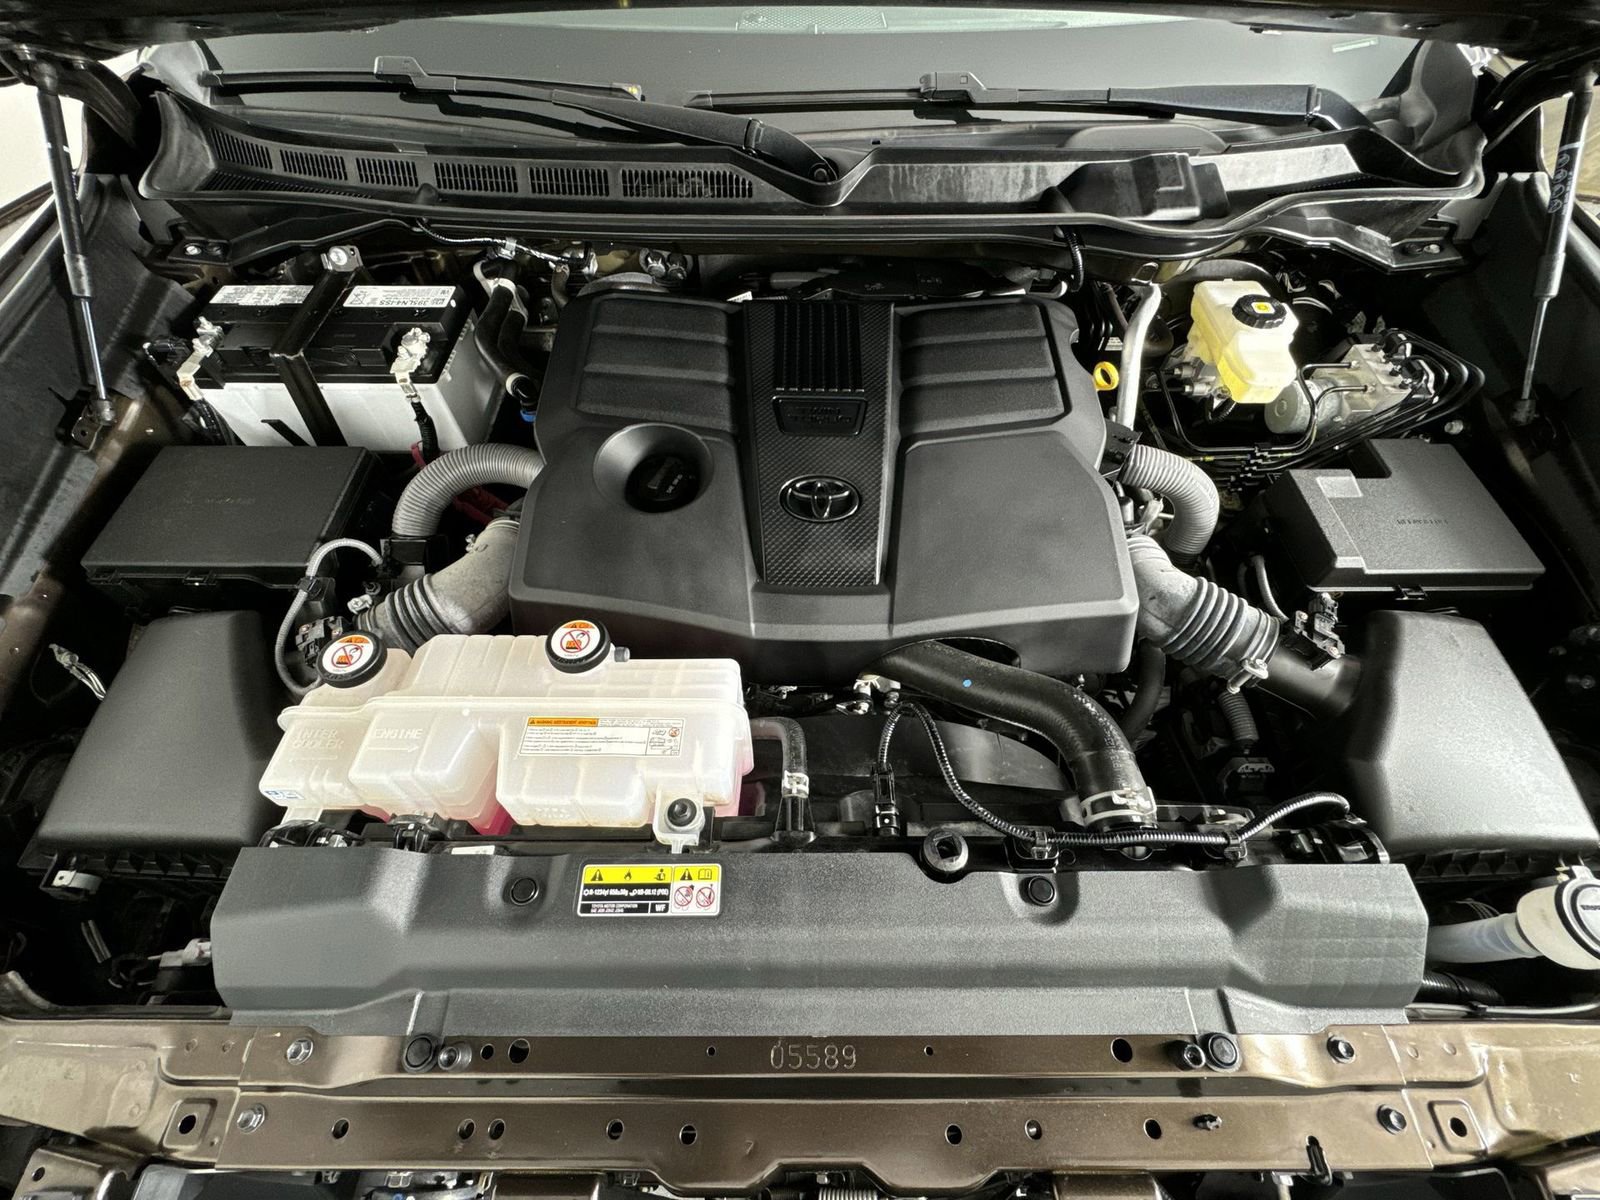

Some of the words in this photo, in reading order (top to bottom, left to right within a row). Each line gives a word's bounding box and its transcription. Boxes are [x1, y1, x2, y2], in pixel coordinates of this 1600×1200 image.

[373, 728, 424, 739] ENGINE
[291, 739, 345, 749] COOLER
[655, 904, 666, 912] WF
[770, 1044, 857, 1070] 05589
